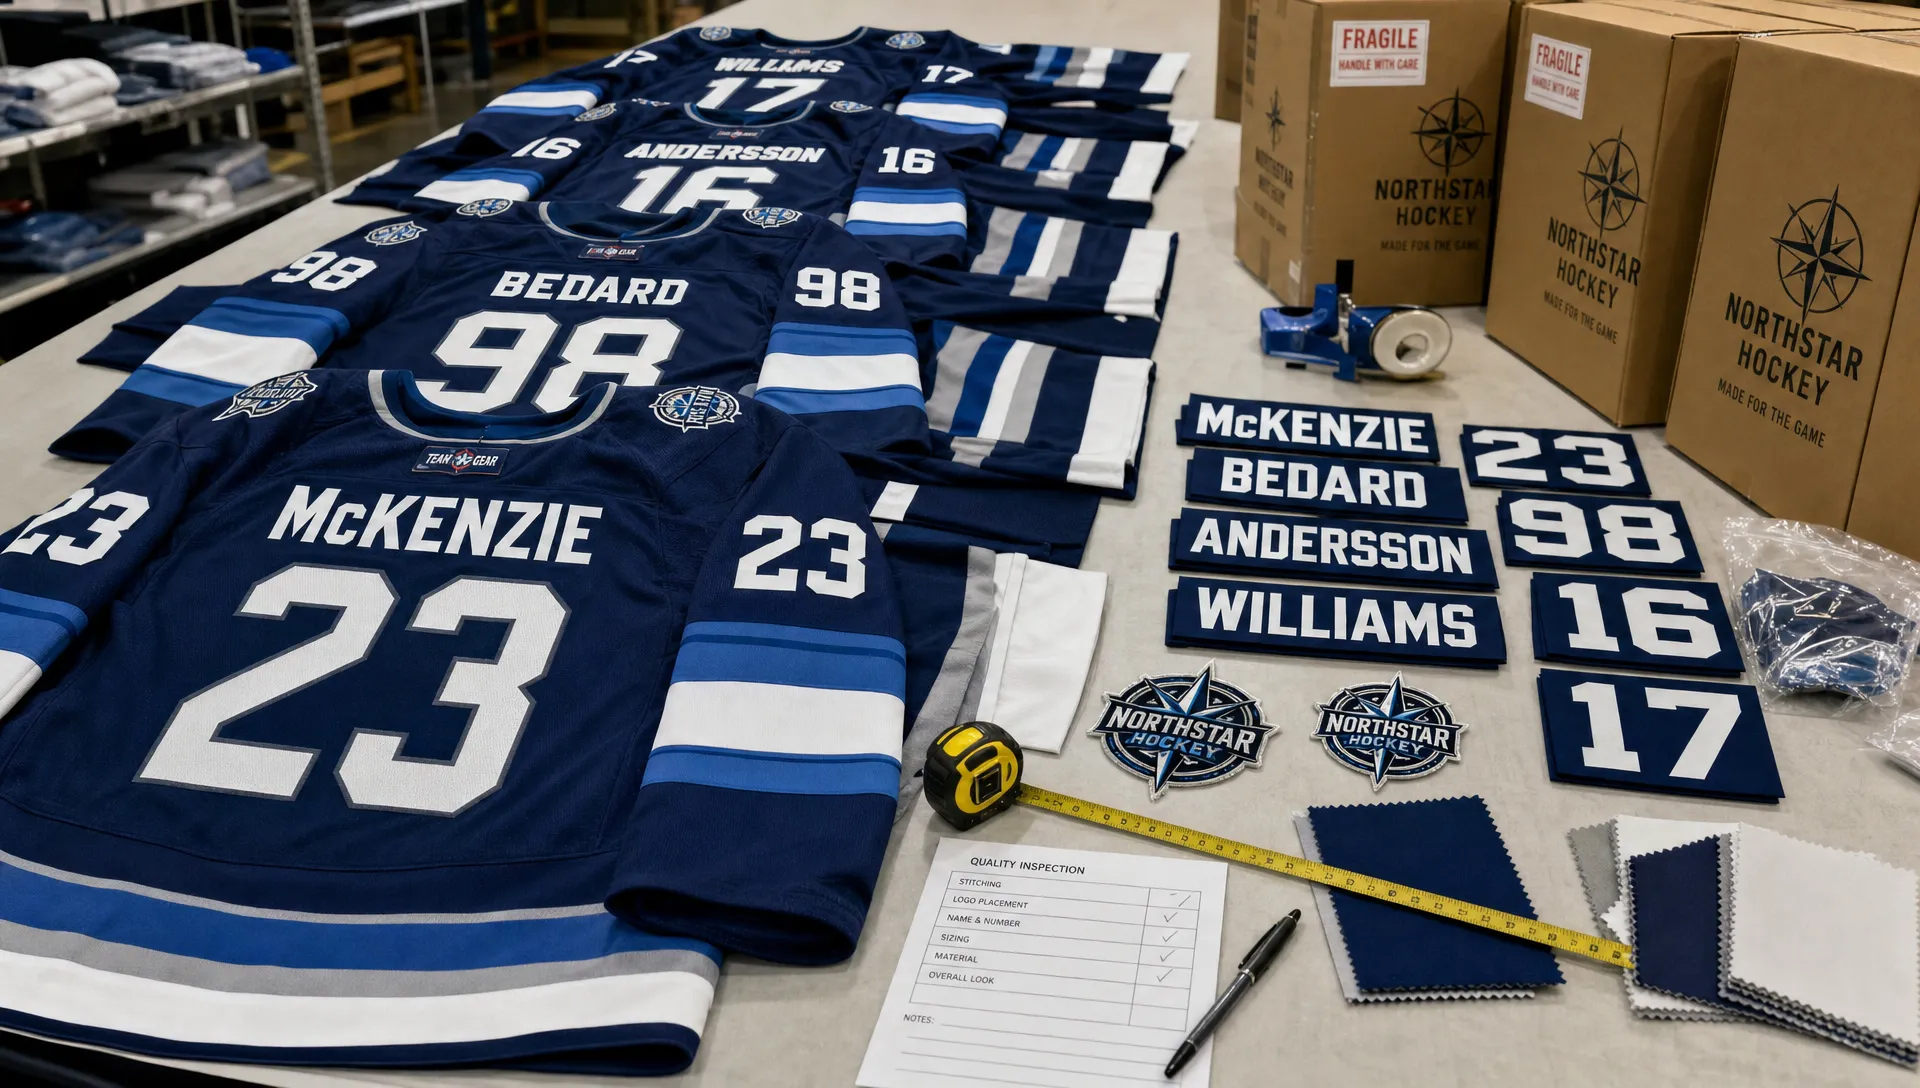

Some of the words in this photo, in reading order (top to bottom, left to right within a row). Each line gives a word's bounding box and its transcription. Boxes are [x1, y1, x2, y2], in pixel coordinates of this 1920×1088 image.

[1343, 28, 1418, 49] FRAGILE
[921, 65, 974, 83] 17
[1338, 59, 1371, 70] HANDLE
[1374, 58, 1395, 70] WITH
[1397, 58, 1418, 70] CARE
[1535, 43, 1583, 77] FRAGILE
[696, 77, 828, 112] 17
[511, 137, 582, 159] 16
[624, 143, 826, 163] ANDERSSON
[878, 147, 936, 174] 16
[617, 165, 779, 213] 16
[1396, 206, 1477, 226] HOCKEY
[271, 251, 378, 291] 98
[1547, 217, 1641, 287] NORTHSTAR
[490, 270, 689, 305] BEDARD
[795, 266, 880, 311] 98
[1557, 257, 1618, 309] HOCKEY
[1544, 290, 1563, 312] MADE
[1564, 302, 1579, 322] FOR
[1580, 311, 1595, 331] THE
[1596, 321, 1618, 345] GAME
[1725, 292, 1863, 381] NORTHSTAR
[415, 308, 684, 414] 98
[1737, 339, 1829, 406] HOCKEY
[1196, 402, 1429, 453] McKENZIE
[1717, 377, 1745, 405] MADE
[1747, 394, 1767, 417] FOR
[1771, 406, 1791, 430] THE
[1794, 419, 1826, 448] GAME
[472, 455, 499, 466] GEAR
[1472, 429, 1635, 487] 23
[1220, 456, 1427, 508] BEDARD
[0, 487, 150, 566] 23
[267, 484, 602, 566] McKENZIE
[1509, 498, 1686, 564] 98
[733, 514, 867, 599] 23
[1190, 518, 1473, 574] ANDERSSON
[1198, 587, 1477, 648] WILLIAMS
[1558, 582, 1721, 659] 16
[132, 562, 571, 817] 23
[1105, 705, 1256, 755] NORTHSTAR
[1133, 731, 1224, 758] HOCKEY
[1325, 712, 1451, 750] NORTHSTAR
[1349, 734, 1425, 755] HOCKEY
[1571, 681, 1742, 780] 17
[959, 878, 1002, 888] STITCHING
[970, 857, 1016, 869] QUALITY
[1019, 861, 1085, 875] INSPECTION
[947, 914, 972, 924] NAME
[975, 916, 982, 924] &
[984, 918, 1021, 928] NUMBER
[953, 896, 976, 905] LOGO
[978, 898, 1029, 909] PLACEMENT
[934, 952, 978, 964] MATERIAL
[940, 934, 970, 944] SIZING
[928, 971, 967, 982] OVERALL
[970, 975, 995, 985] LOOK
[903, 1013, 935, 1026] NOTES:
